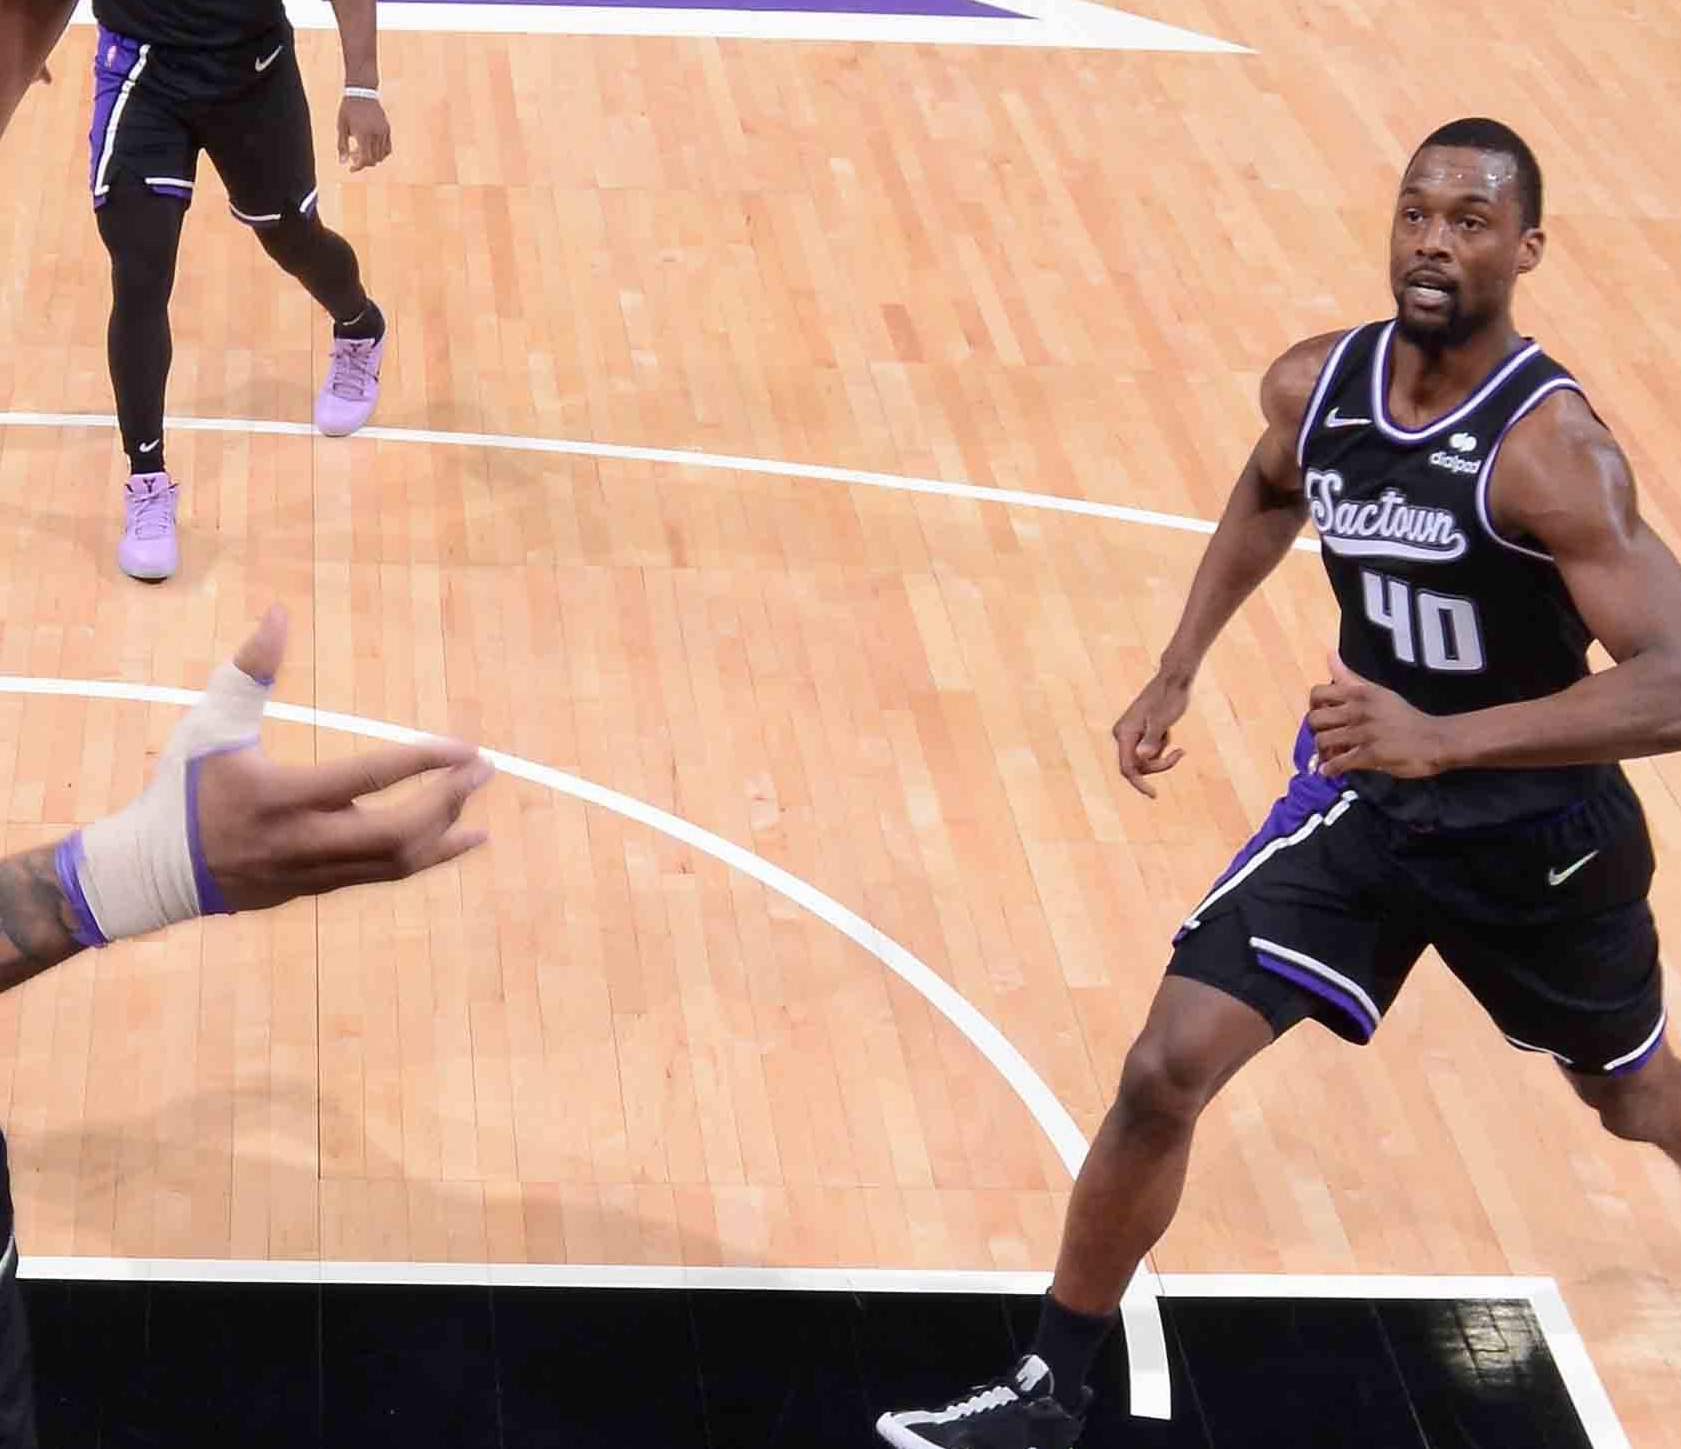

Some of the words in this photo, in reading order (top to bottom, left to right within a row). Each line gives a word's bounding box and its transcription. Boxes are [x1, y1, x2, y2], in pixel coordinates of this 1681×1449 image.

[1429, 451, 1481, 475] dialpad
[1305, 467, 1468, 561] Sactown
[1361, 566, 1485, 672] 40
